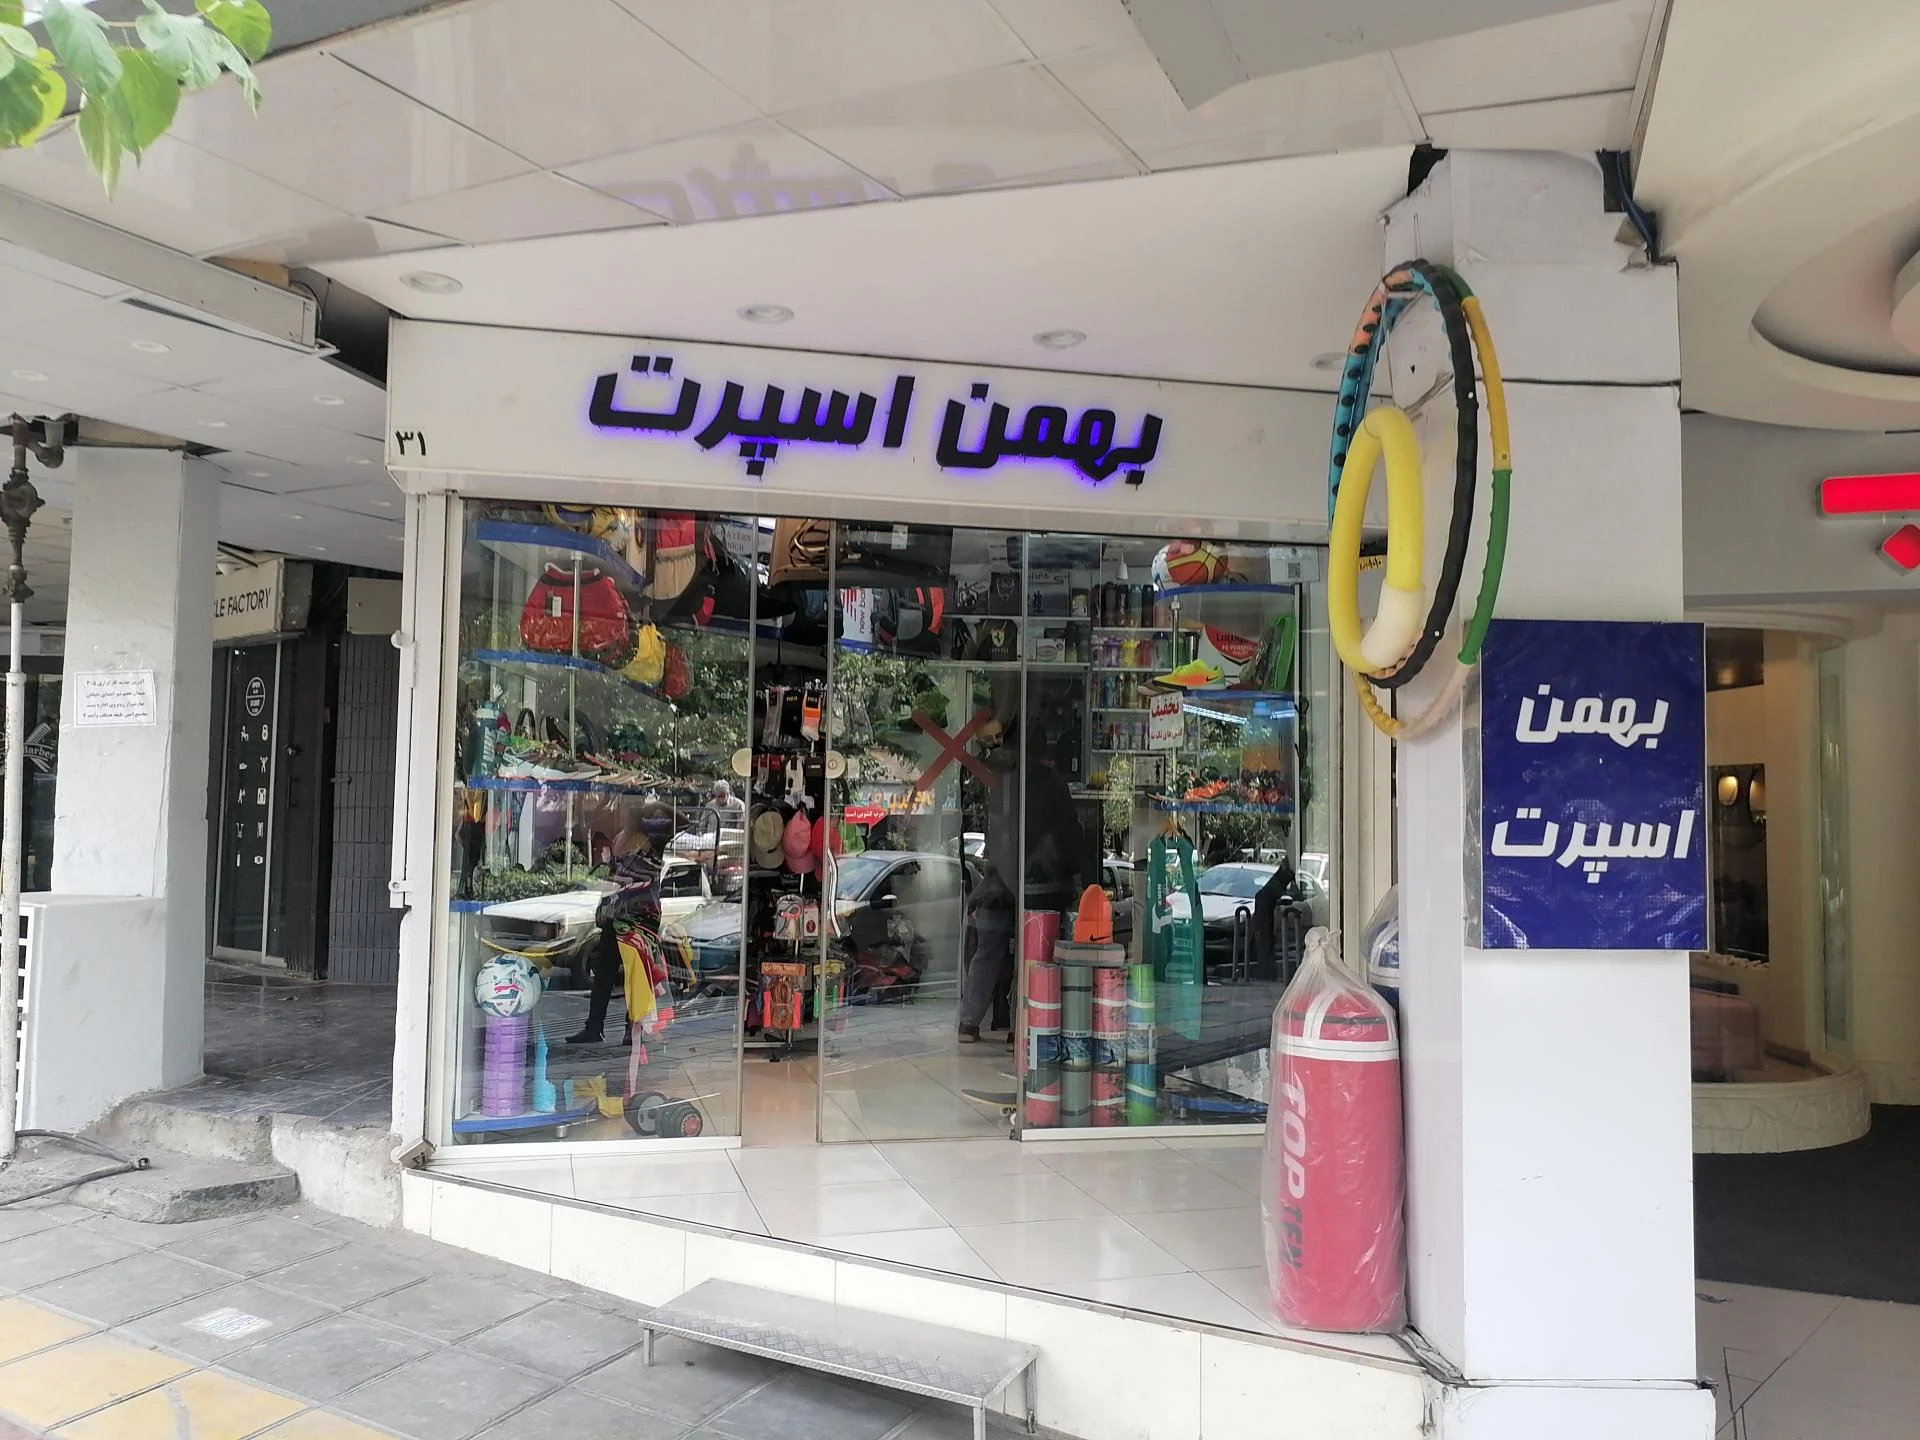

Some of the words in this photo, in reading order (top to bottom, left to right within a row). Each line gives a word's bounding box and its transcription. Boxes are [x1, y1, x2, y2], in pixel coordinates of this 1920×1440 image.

[396, 430, 426, 456] ۳۱
[589, 355, 915, 475] اسپرت
[936, 383, 1163, 485] بهمن
[227, 587, 272, 617] FACTORY
[1151, 696, 1180, 722] تخفیف
[1515, 684, 1669, 749] بهمن
[1491, 808, 1695, 883] اسپرت
[1283, 1071, 1306, 1199] TOP
